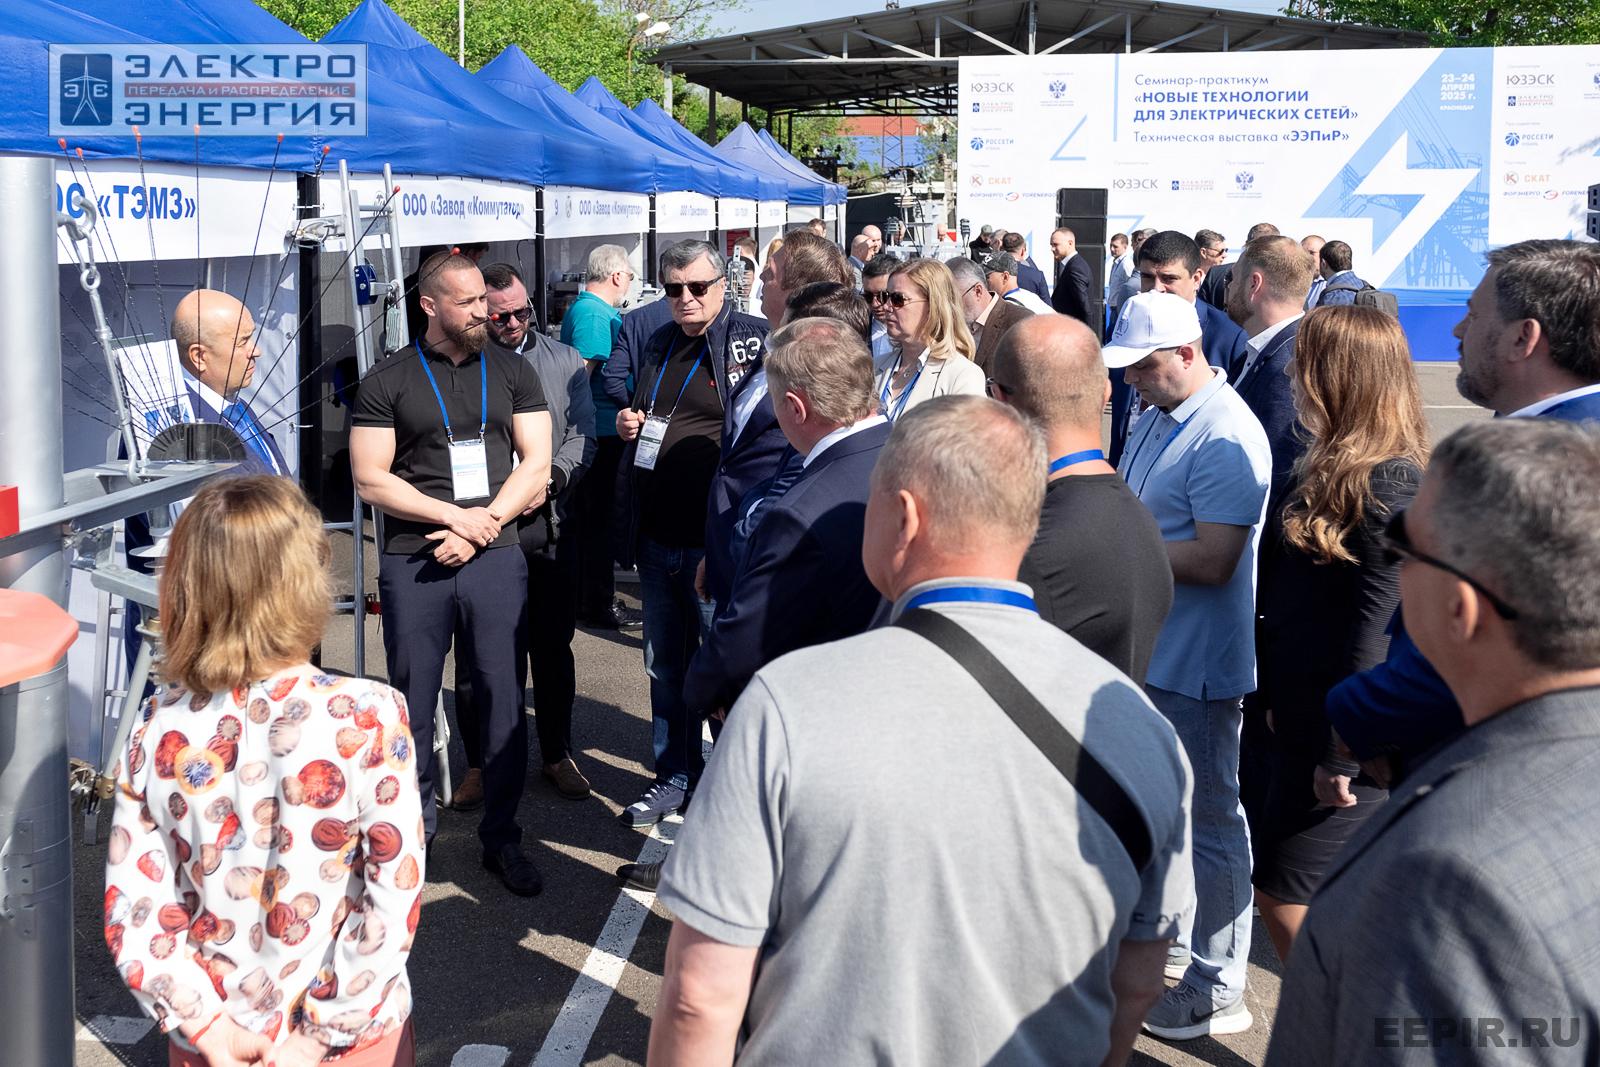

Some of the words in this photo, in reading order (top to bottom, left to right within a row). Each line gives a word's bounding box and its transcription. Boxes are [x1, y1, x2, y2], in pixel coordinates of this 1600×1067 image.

[1135, 74, 1269, 88] Семинар-практикум
[1506, 74, 1555, 85] ЮЗЭСК
[971, 82, 1014, 93] ЮЗЭСК
[1135, 91, 1198, 103] «НОВЫЕ
[1202, 90, 1309, 103] ТЕХНОЛОГИИ
[1440, 91, 1466, 100] 2025
[1134, 109, 1165, 122] ДЛЯ
[1169, 108, 1300, 121] ЭЛЕКТРИЧЕСКИХ
[1304, 106, 1358, 120] СЕТЕЙ»
[1134, 131, 1215, 143] Техническая
[1218, 132, 1278, 143] выставка
[1283, 130, 1349, 142] «ЭЭПиР»
[1113, 179, 1159, 189] ЮЗЭСК
[97, 184, 197, 220] «ТЭМЗ»
[402, 193, 427, 216] ООО
[430, 193, 465, 220] «Завод
[467, 195, 525, 221] «Коммутатор»
[731, 336, 761, 364] 63
